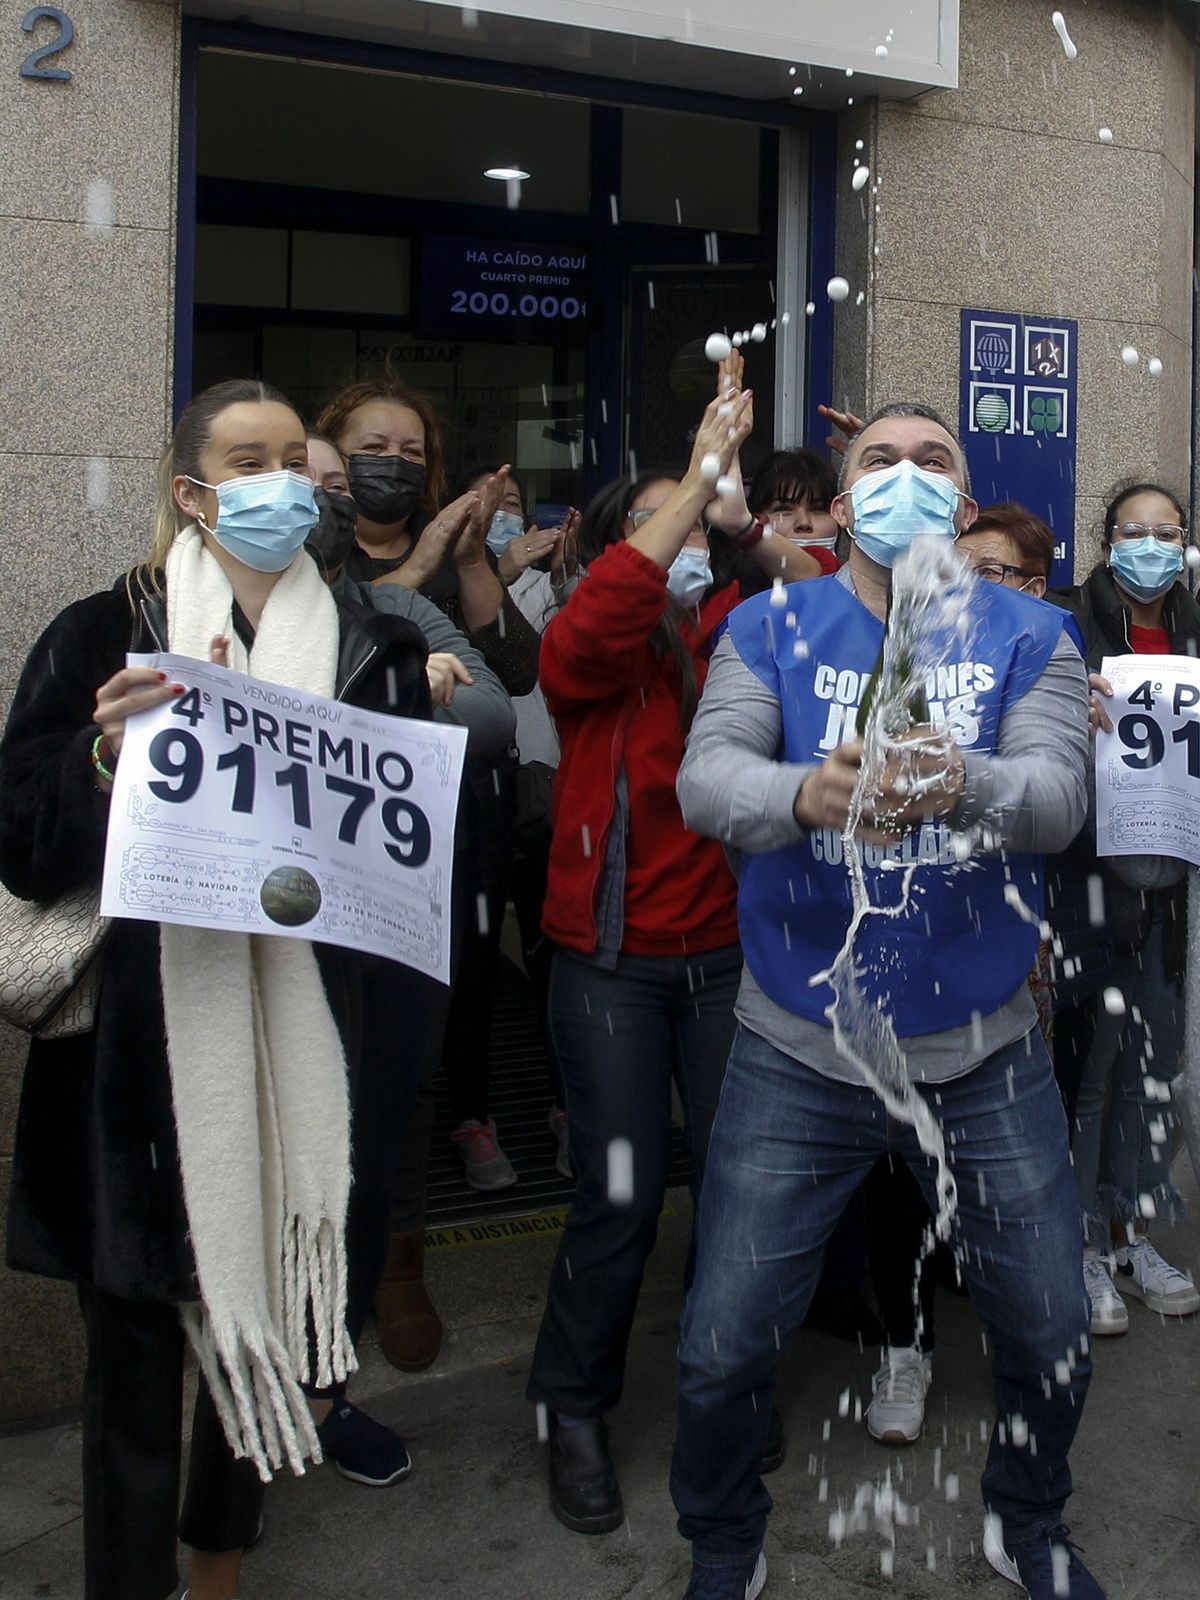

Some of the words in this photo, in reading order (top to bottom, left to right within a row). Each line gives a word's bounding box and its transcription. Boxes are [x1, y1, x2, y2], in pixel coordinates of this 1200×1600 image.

[20, 6, 75, 81] 2
[466, 250, 488, 263] HA
[493, 250, 543, 267] CAÍDO
[547, 255, 586, 269] AQUÍ
[480, 271, 526, 283] CUARTO
[529, 274, 570, 286] PREMIO
[241, 683, 303, 713] VENDIDO
[305, 705, 342, 723] AQUÍ
[1127, 679, 1163, 711] 4º
[171, 687, 214, 727] 4º
[222, 697, 414, 792] PREMIO
[147, 728, 432, 869] 91179
[1126, 819, 1158, 828] LOTERÍA
[143, 873, 180, 885] LOTERÍA
[198, 881, 238, 893] NAVIDAD
[453, 1229, 467, 1243] A
[470, 1215, 565, 1240] DISTANCIA
